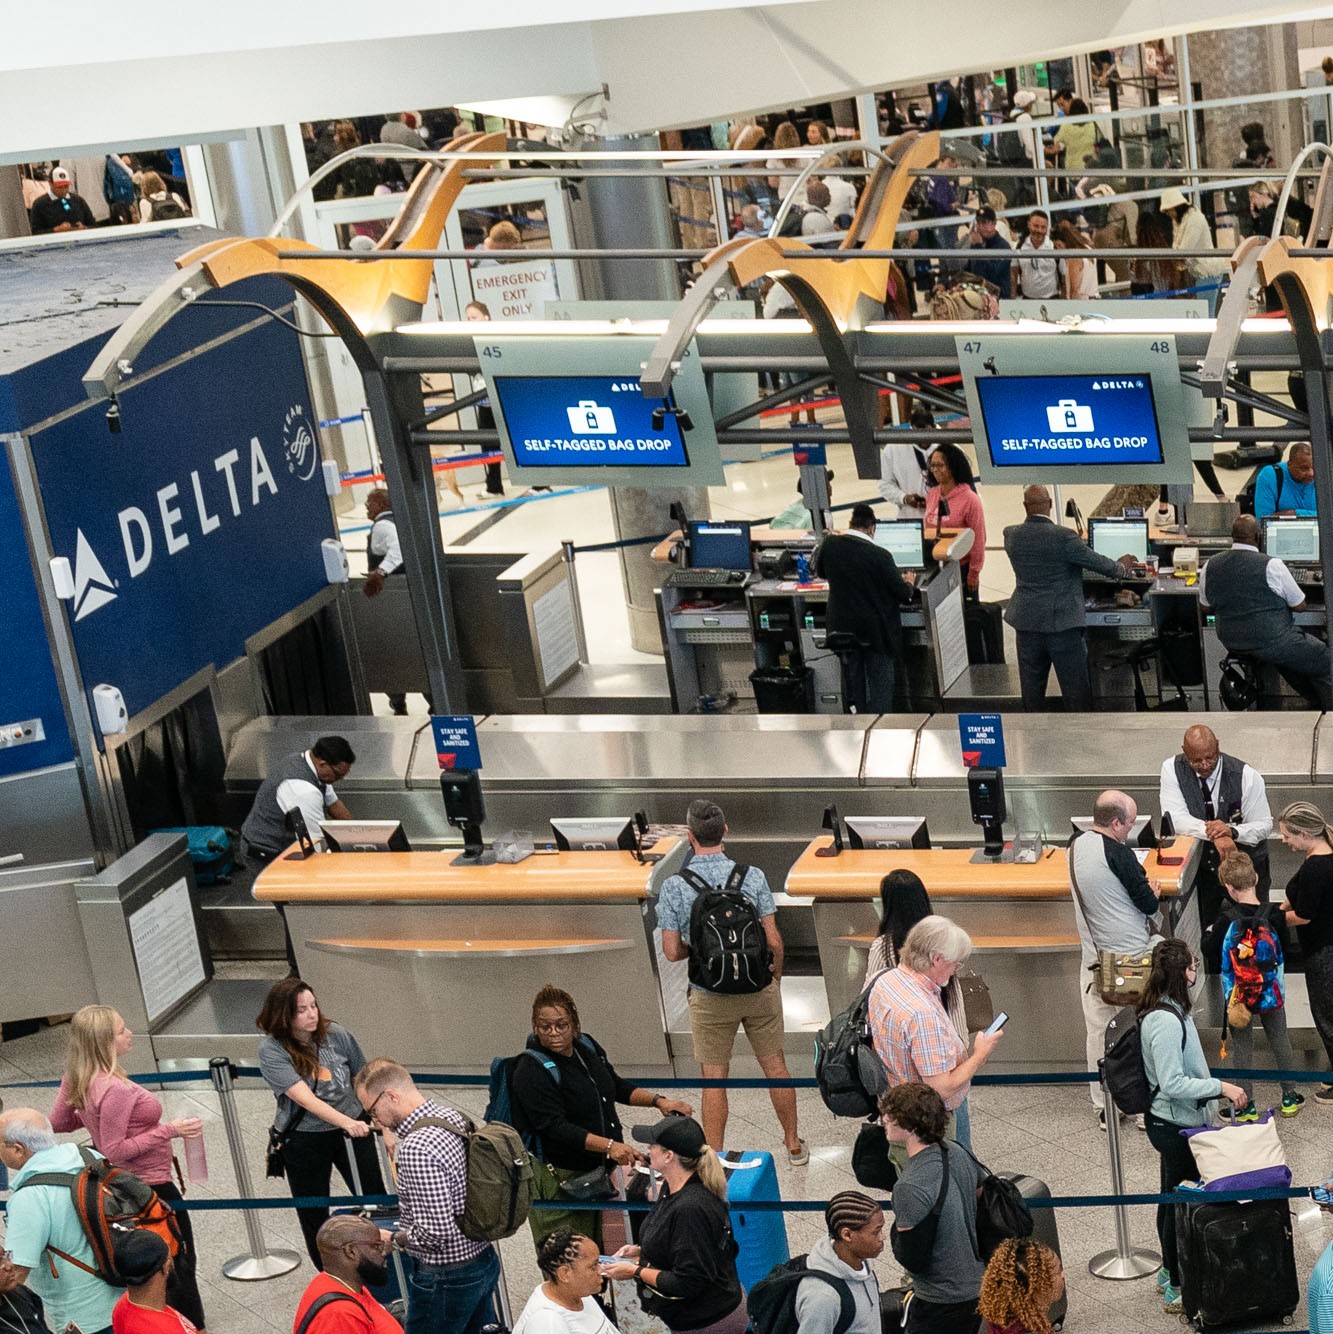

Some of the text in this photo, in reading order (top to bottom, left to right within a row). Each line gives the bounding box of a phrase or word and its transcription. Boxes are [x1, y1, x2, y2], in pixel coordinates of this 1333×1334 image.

[476, 271, 549, 290] EMERGENCY
[502, 288, 529, 302] EXIT
[502, 303, 533, 317] ONLY
[483, 346, 503, 359] 45
[963, 342, 982, 354] 47
[1150, 342, 1169, 354] 48
[1102, 381, 1135, 389] DELTA
[523, 438, 673, 452] SELF-TAGGED BAG DROP
[1002, 436, 1148, 451] SELF-TAGGED BAG DROP
[117, 436, 278, 578] DELTA
[454, 728, 469, 736] SAFE
